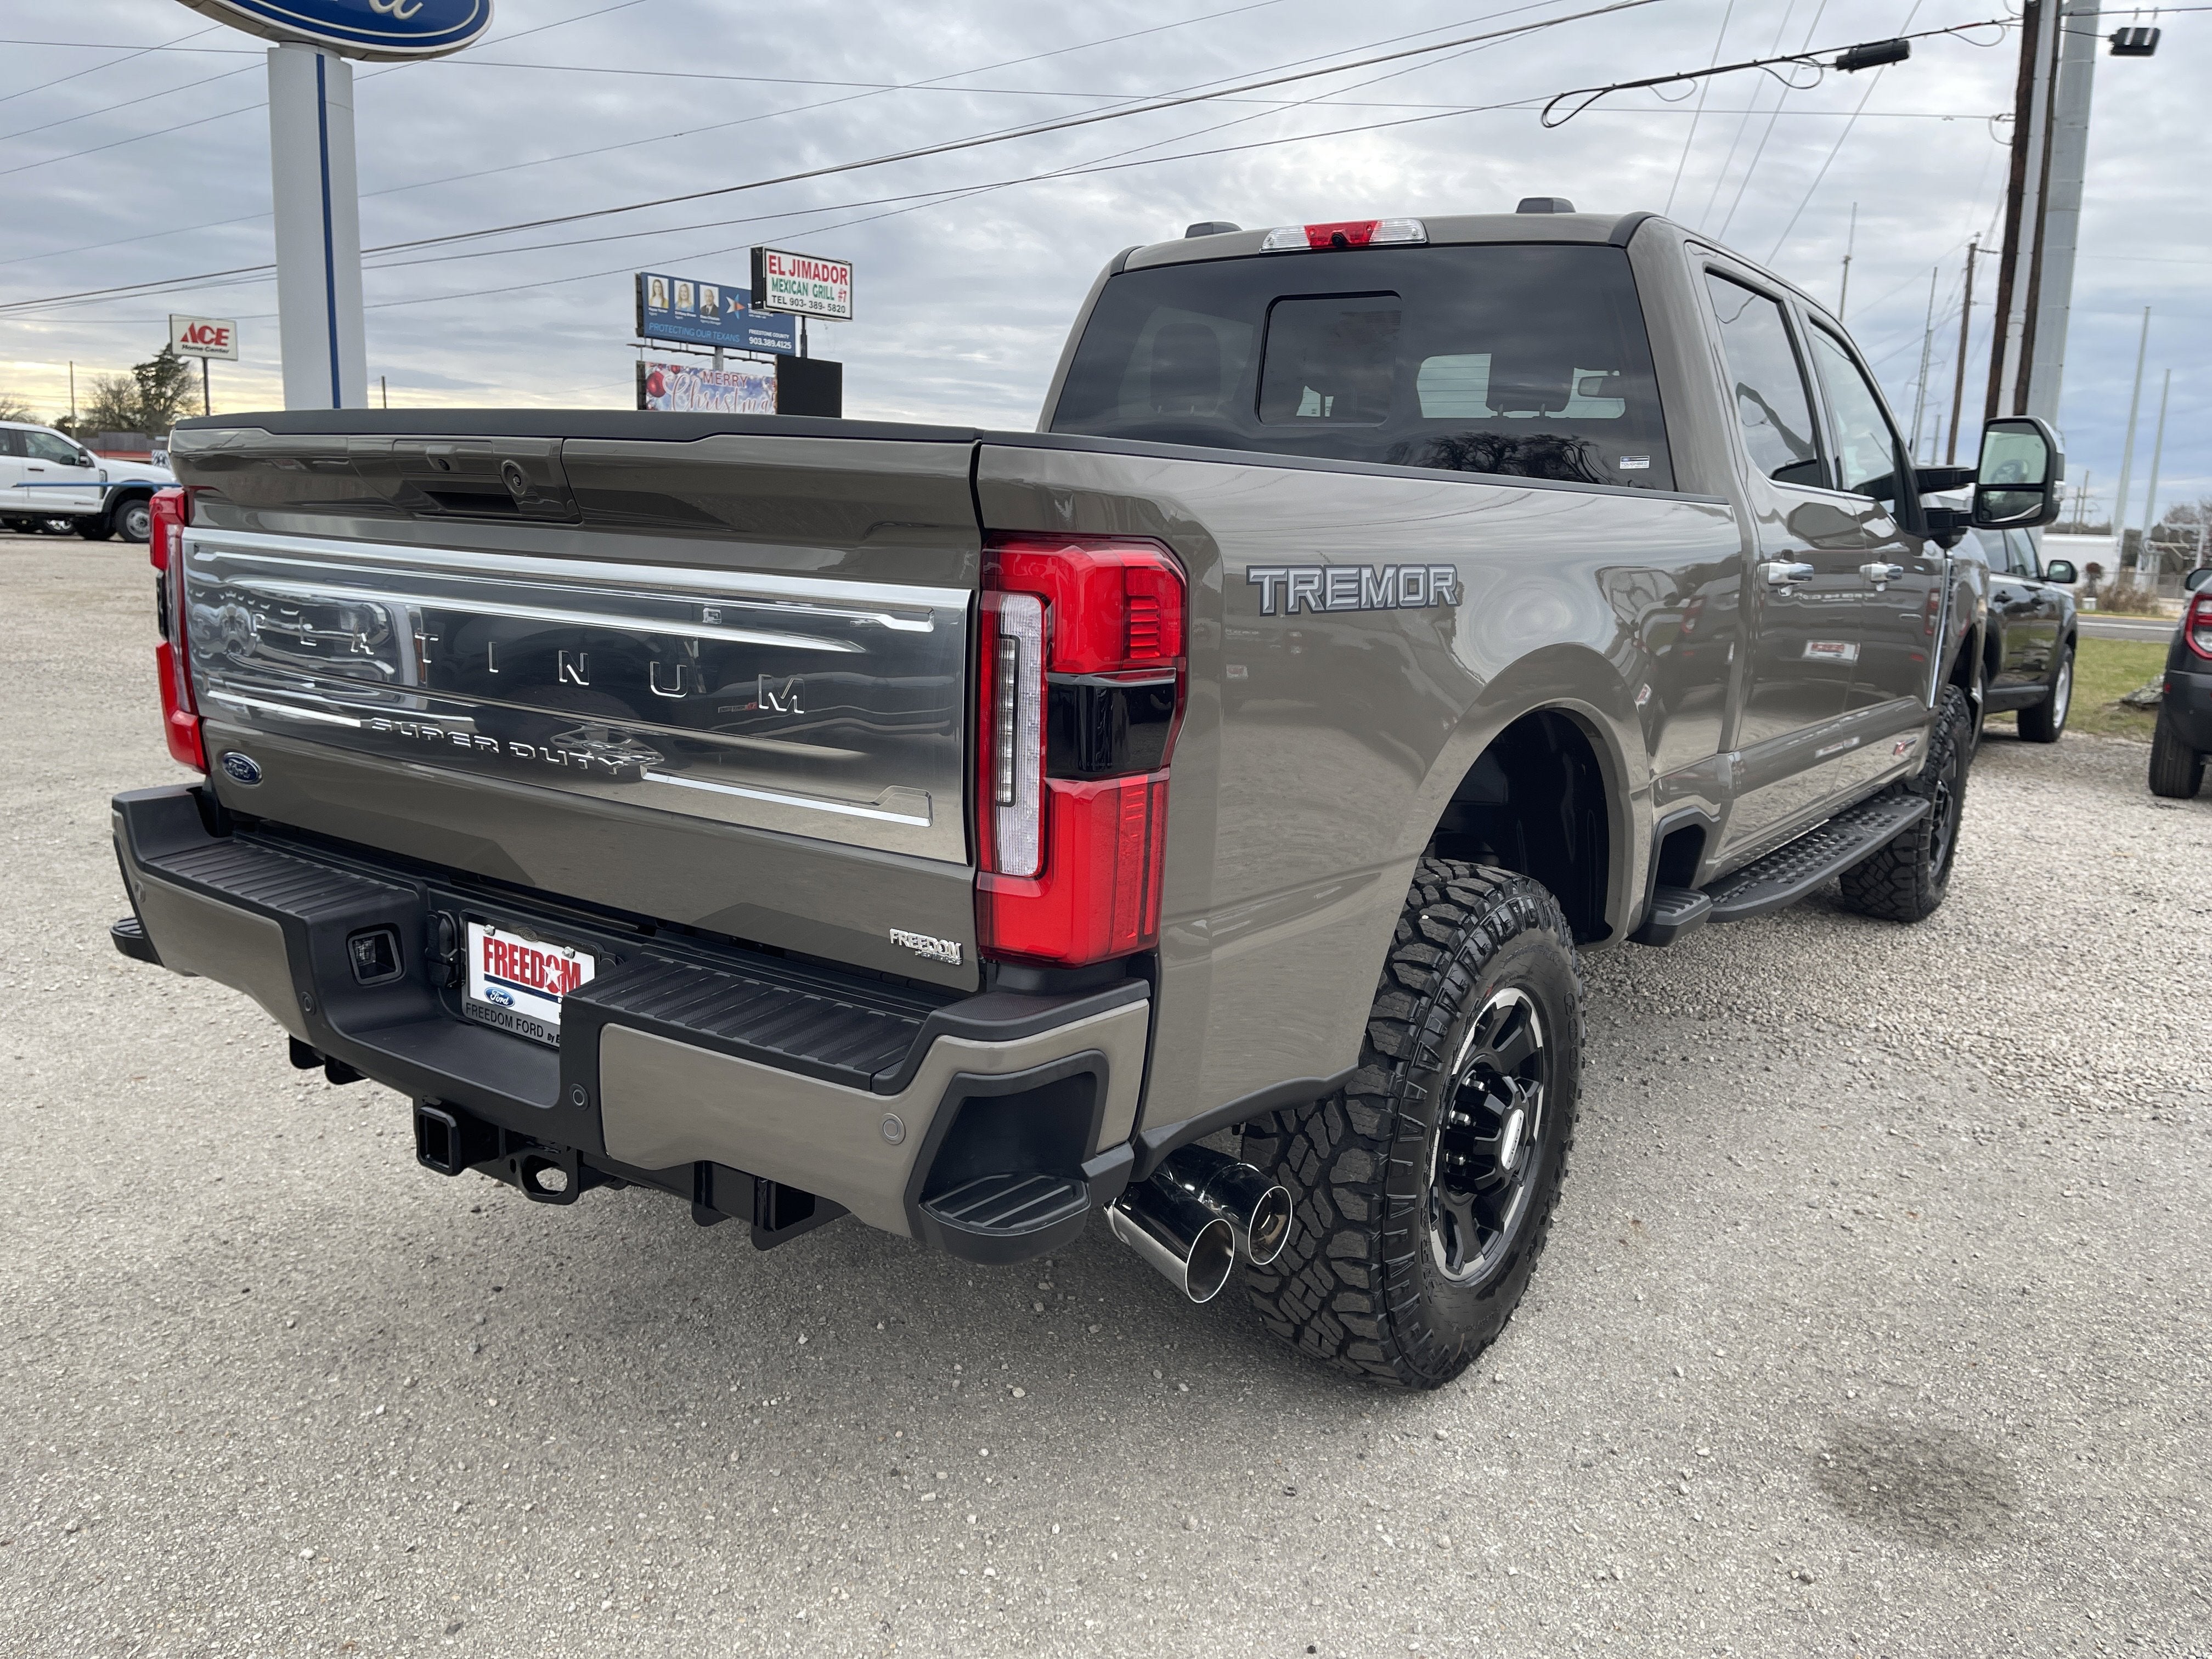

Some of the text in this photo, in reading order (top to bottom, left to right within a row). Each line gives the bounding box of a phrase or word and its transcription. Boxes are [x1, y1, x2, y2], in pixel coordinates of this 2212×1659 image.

[768, 255, 848, 285] EL JIMADOR
[771, 277, 808, 296] MEXICAN
[812, 284, 834, 301] GRILL
[771, 295, 845, 313] TEL 903- 389- 5820
[180, 322, 229, 346] ACE
[648, 323, 740, 343] PROTECTING OUR TEXANS
[703, 370, 748, 388] MERRY
[1246, 563, 1463, 617] TREMOR
[371, 716, 625, 776] SUPER DUTY
[889, 928, 963, 959] FREEDOM
[483, 936, 582, 996] FREEDOM
[489, 989, 509, 1006] Ford
[466, 1002, 514, 1029] FREEDOM
[516, 1019, 544, 1038] FORD
[547, 1033, 555, 1043] By
